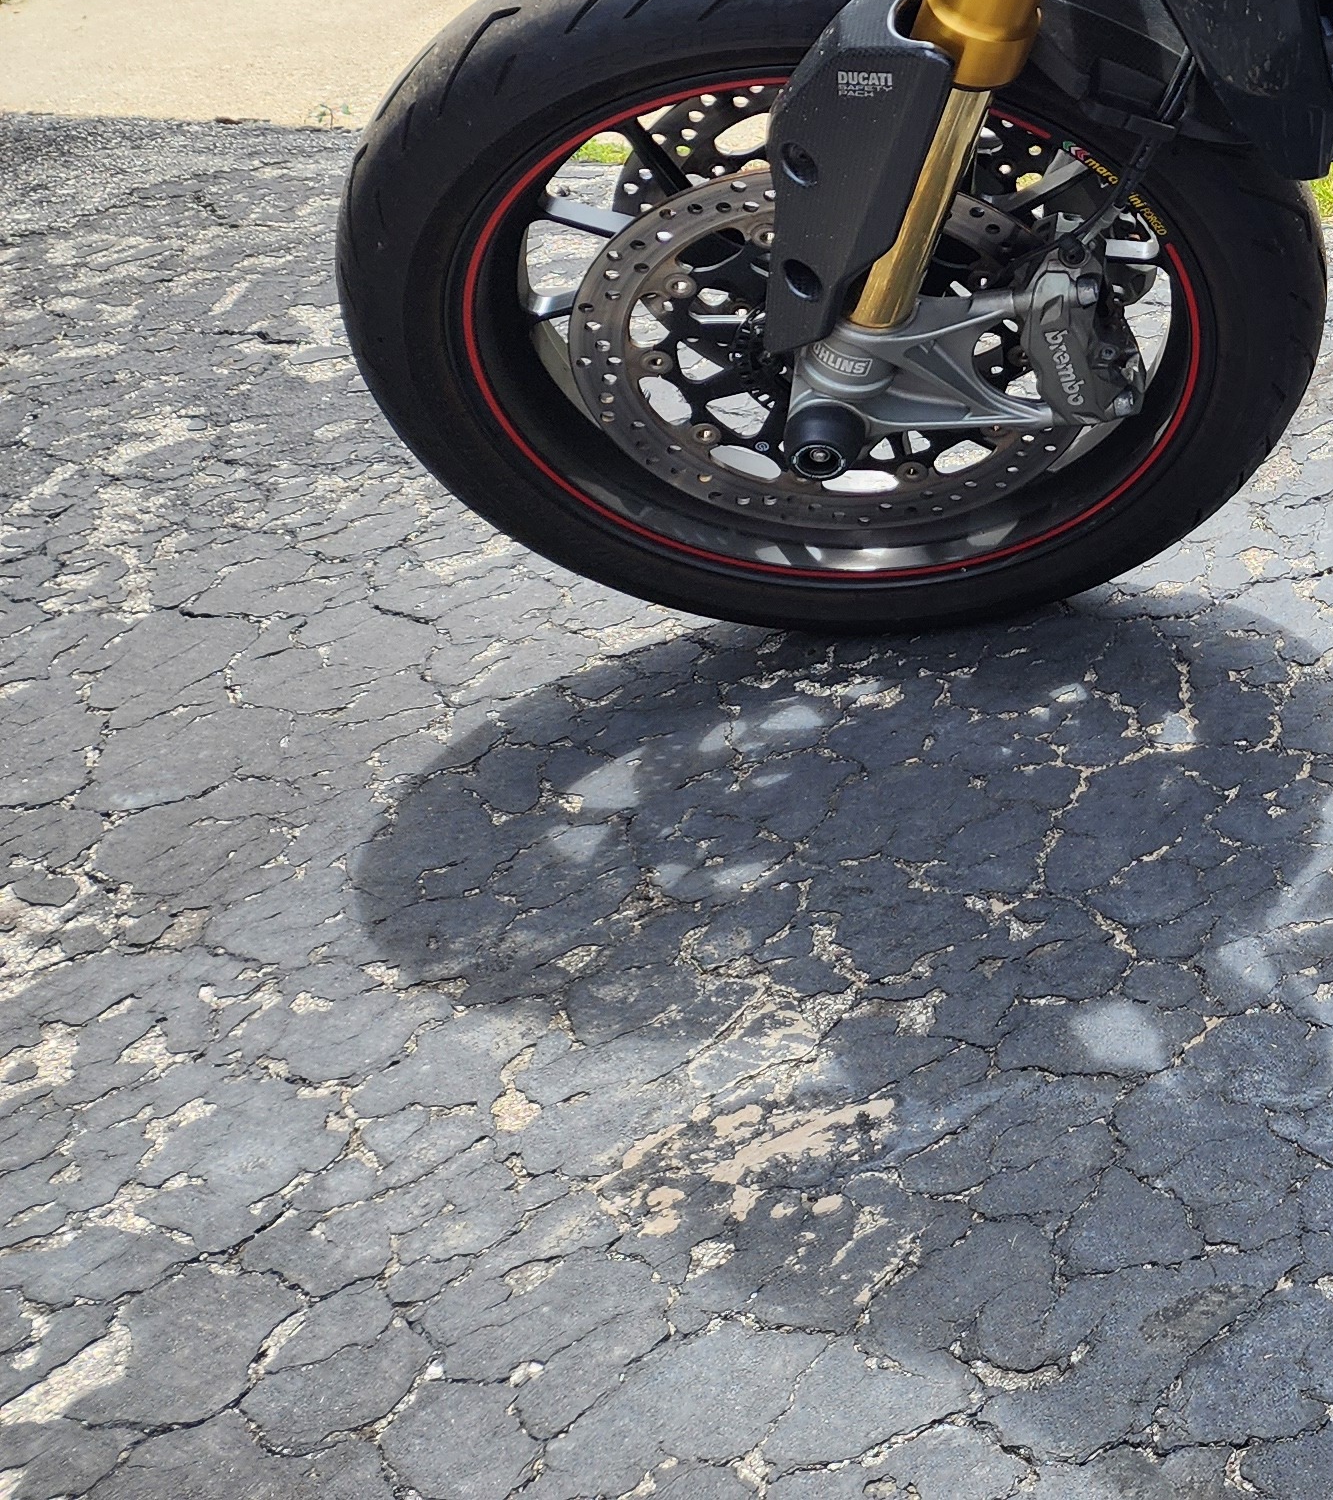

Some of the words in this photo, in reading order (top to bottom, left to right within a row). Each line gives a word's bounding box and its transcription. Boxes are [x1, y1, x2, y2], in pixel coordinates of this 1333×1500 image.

[837, 71, 893, 86] DUCATI
[1140, 207, 1168, 236] FORGED
[1044, 329, 1085, 406] brembo
